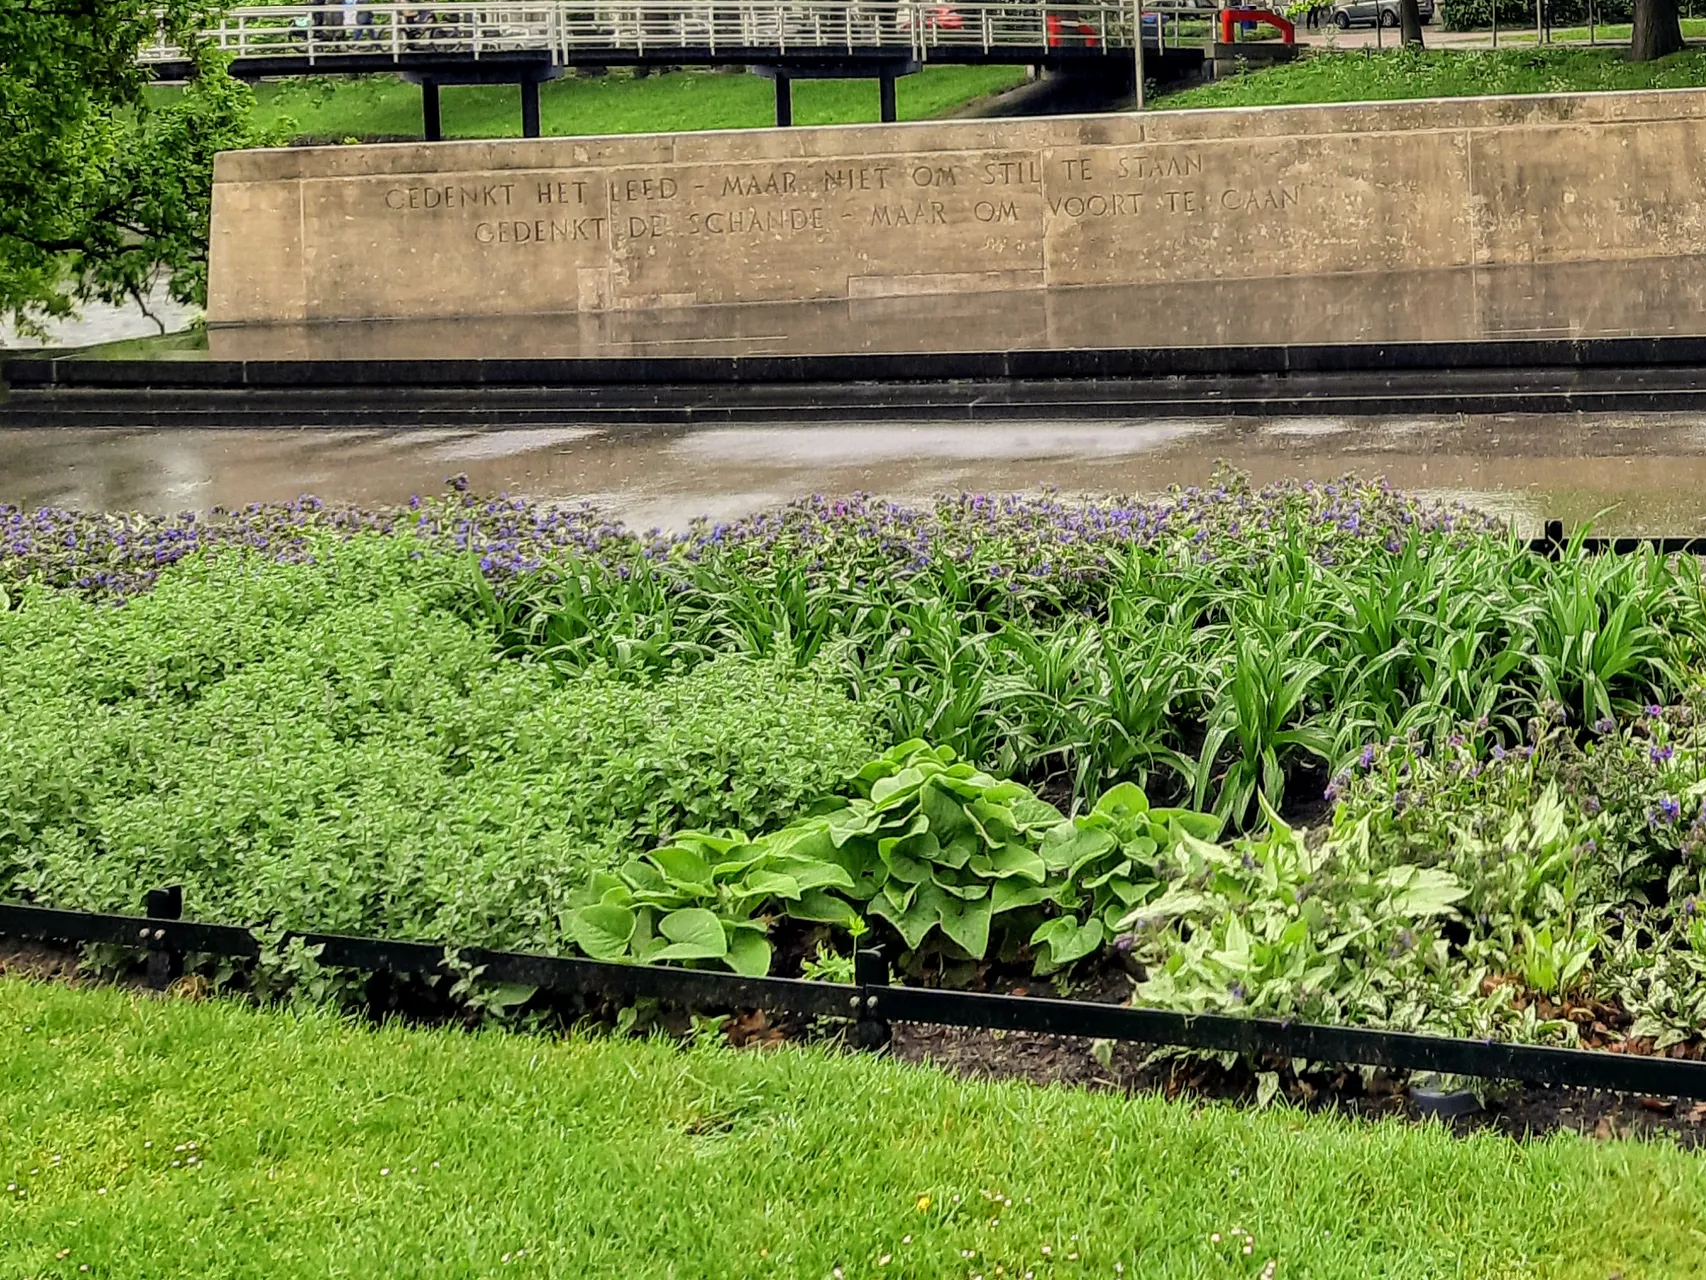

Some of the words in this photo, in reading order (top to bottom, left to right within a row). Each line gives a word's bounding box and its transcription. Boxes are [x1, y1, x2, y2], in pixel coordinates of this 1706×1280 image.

[538, 181, 588, 204] HET
[610, 177, 678, 202] LEED
[721, 171, 797, 197] MAAR
[825, 166, 889, 192] NIET
[912, 164, 957, 189] OM
[984, 161, 1042, 186] STIL
[1062, 158, 1093, 181] TE
[1118, 154, 1203, 179] STAAN
[474, 217, 606, 244] GEDENKT
[629, 215, 663, 239] DE
[689, 207, 824, 235] SCHANDE
[870, 202, 946, 227] MAAR
[974, 199, 1018, 223] OM
[1045, 193, 1144, 218] VOORT
[1165, 190, 1196, 213] TE
